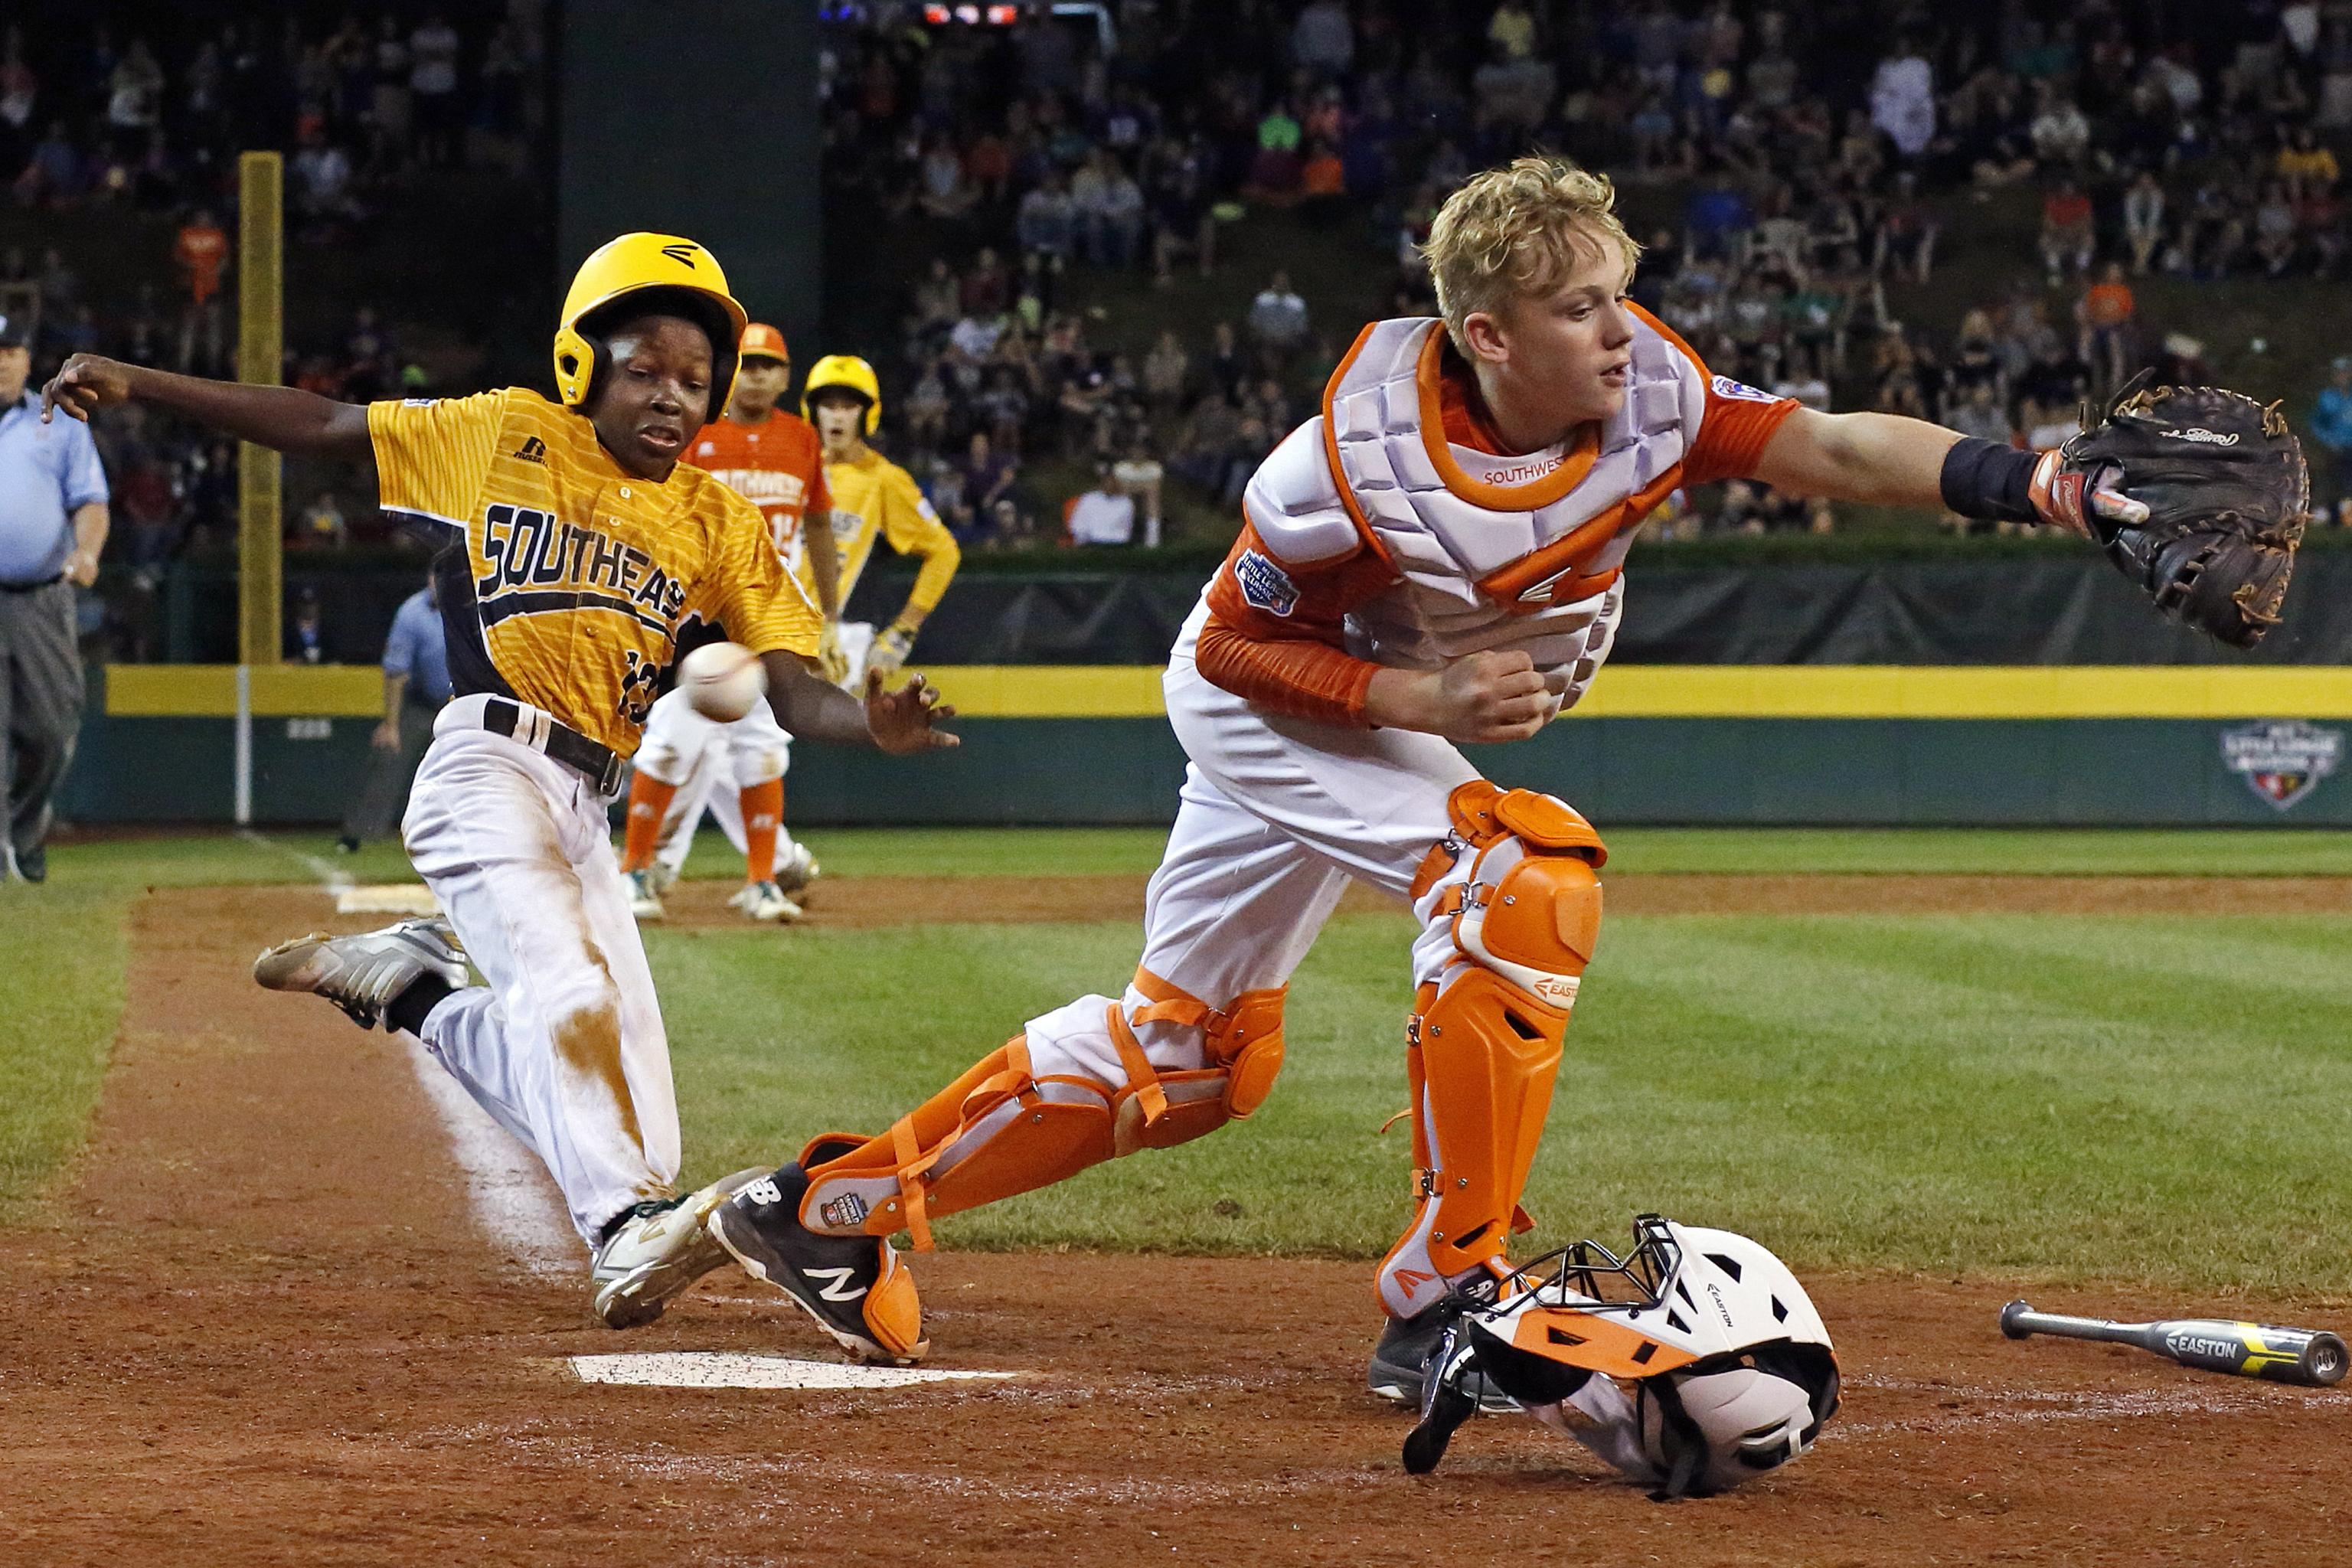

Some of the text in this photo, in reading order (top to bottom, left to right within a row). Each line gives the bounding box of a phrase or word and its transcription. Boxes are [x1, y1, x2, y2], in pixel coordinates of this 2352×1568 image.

[1485, 456, 1563, 485] SOUTHWES
[479, 501, 686, 621] SOUTHEAS
[1243, 556, 1292, 602] LITTLE LEAGUE
[1247, 574, 1274, 601] CLASSIC
[1550, 984, 1578, 998] EAST
[1711, 1291, 1733, 1328] EASTON
[2178, 1336, 2237, 1359] EASTON
